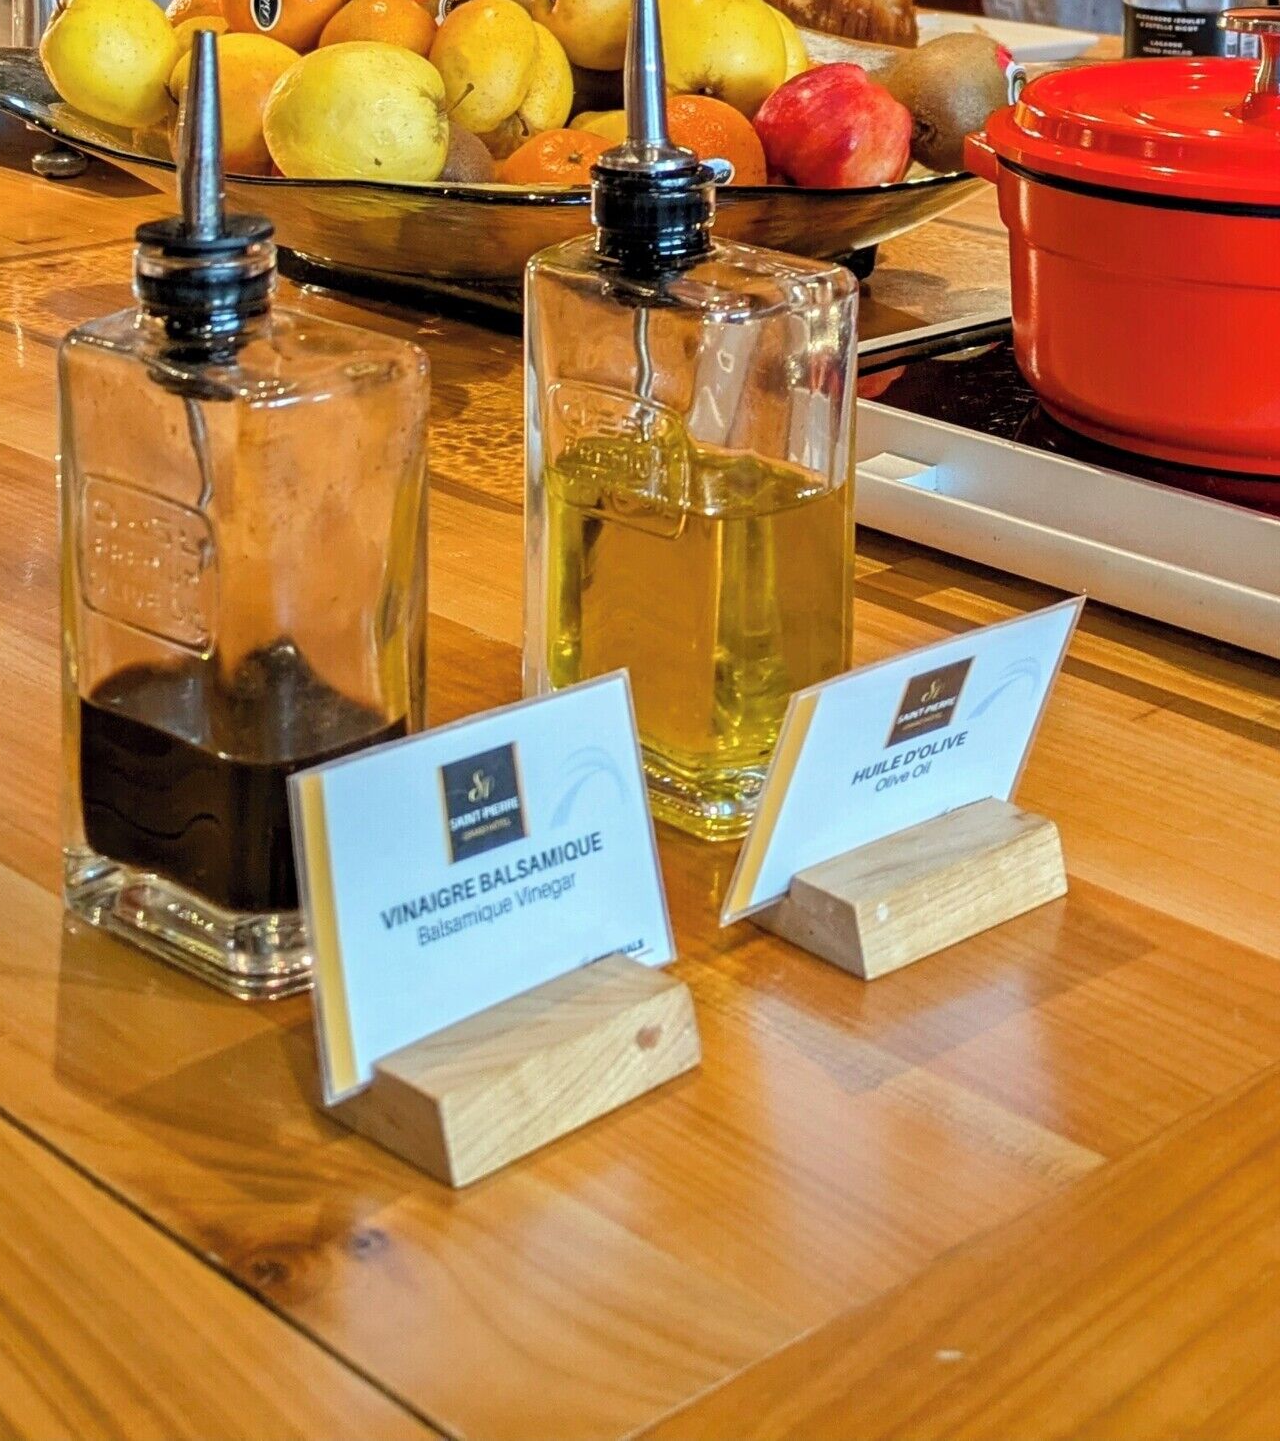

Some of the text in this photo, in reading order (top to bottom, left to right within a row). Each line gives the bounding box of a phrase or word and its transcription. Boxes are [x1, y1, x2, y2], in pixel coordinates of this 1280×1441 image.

[851, 730, 969, 786] HUILE D'OLIVE
[874, 760, 933, 793] Olive Oil
[379, 831, 604, 930] VINAIGRE BALSAMIQUE
[416, 871, 577, 947] Balsamique Vinegar
